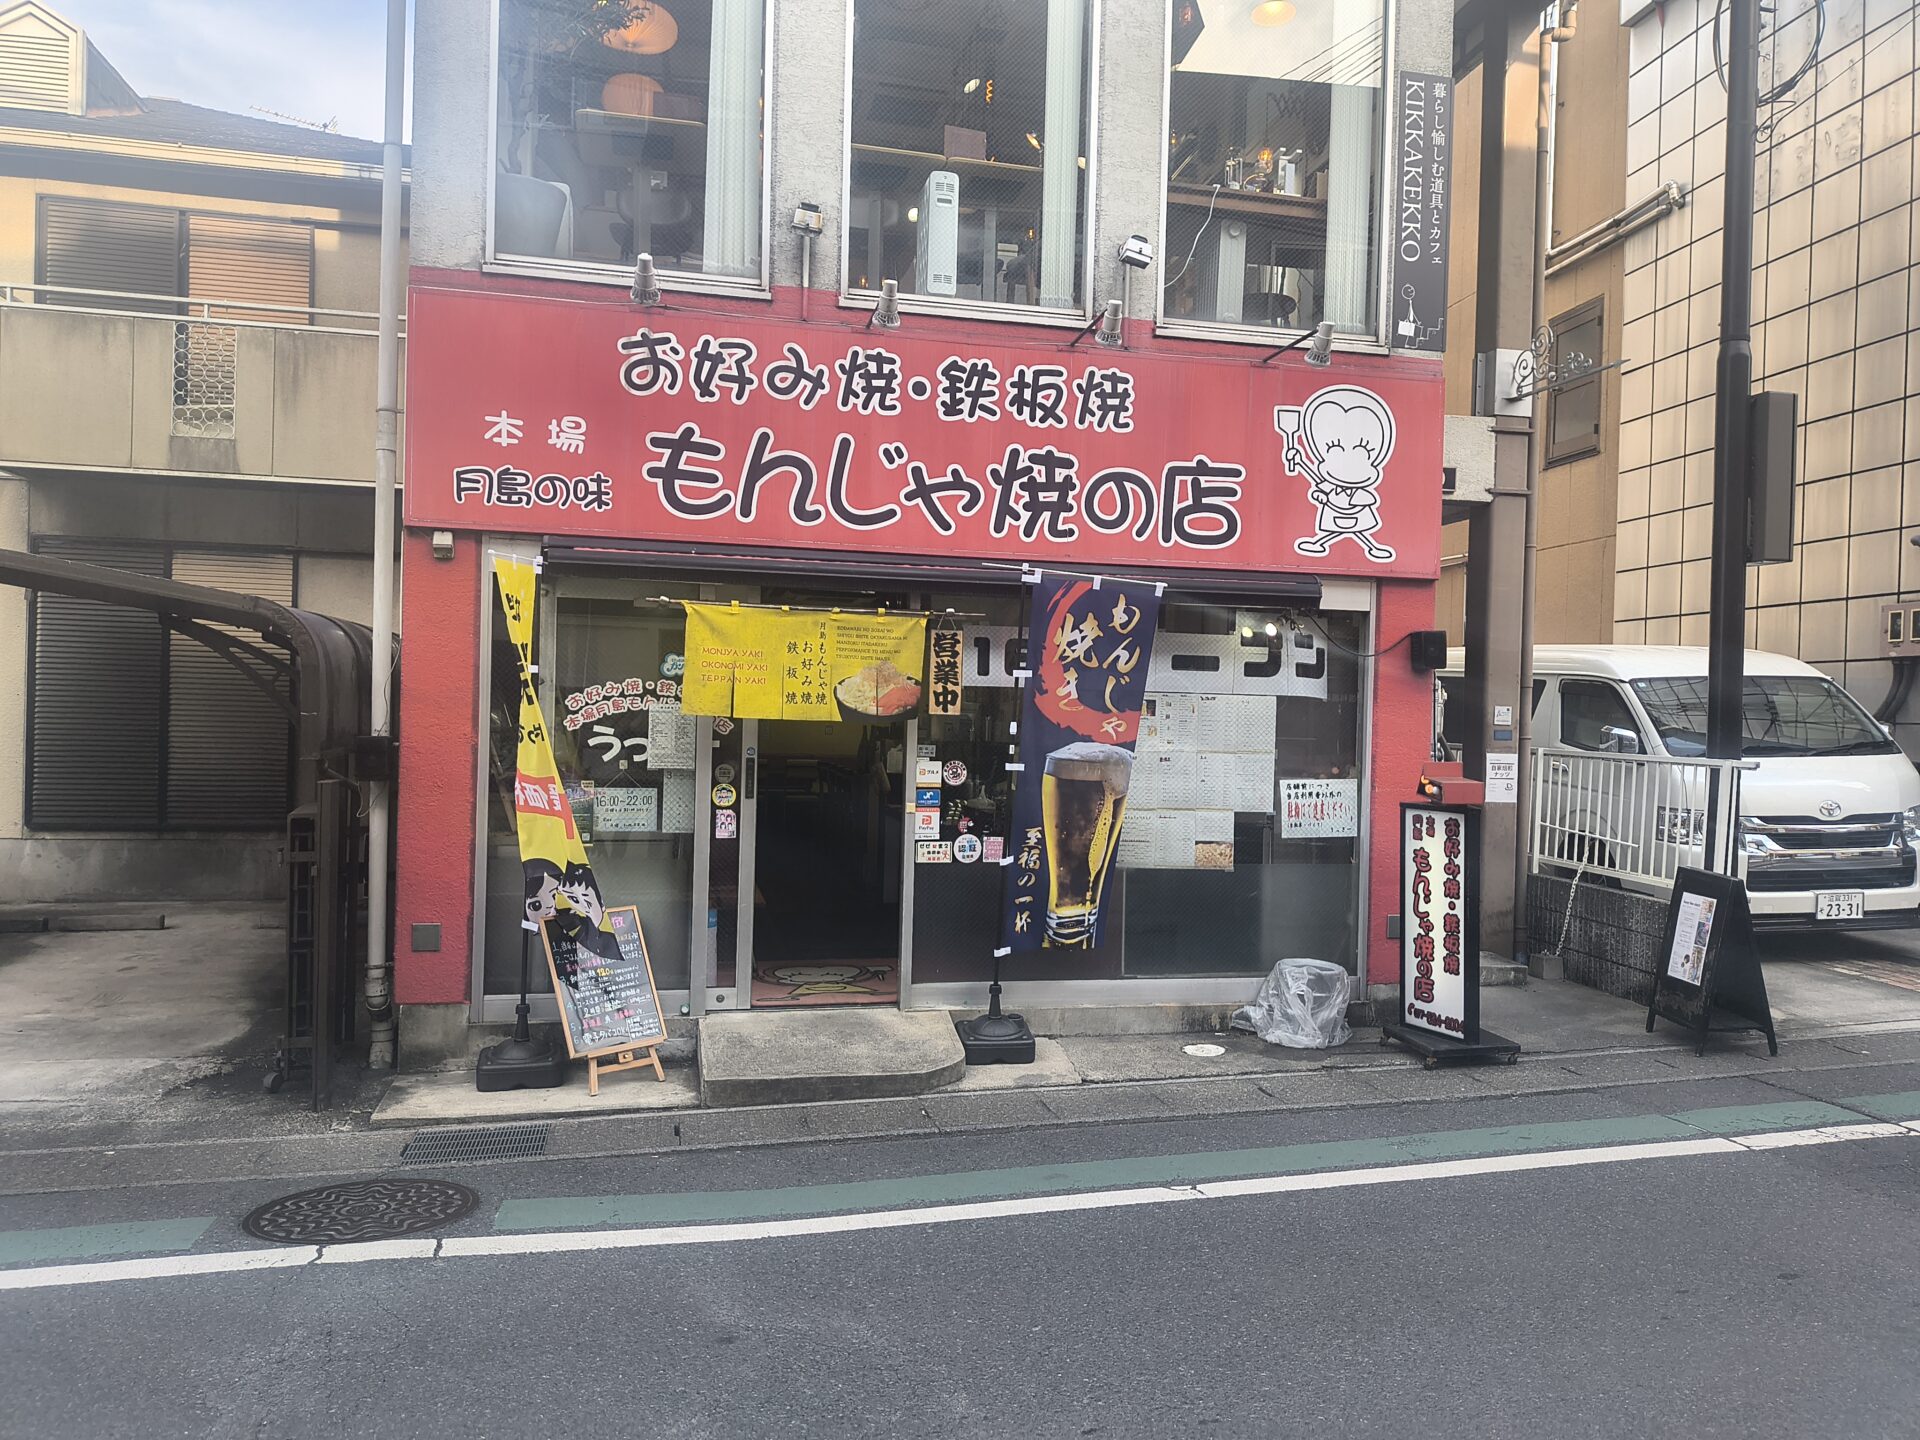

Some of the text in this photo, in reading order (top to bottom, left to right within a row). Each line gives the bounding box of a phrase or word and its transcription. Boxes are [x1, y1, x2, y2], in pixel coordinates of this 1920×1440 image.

[1400, 78, 1425, 263] KIKKAKEKKO
[1428, 82, 1446, 264] 暮らし愉しむ道具とカフェ
[617, 327, 1135, 433] お好み焼・鉄板焼
[484, 410, 588, 455] 本場
[453, 465, 613, 511] 月島の味
[642, 422, 1246, 549] もんじゃ焼の店
[701, 660, 768, 672] OKONOMI YAKI
[701, 673, 766, 685] TEPPAN YAKI
[702, 647, 763, 658] MONJYA YAKI
[785, 640, 799, 705] 鉄板焼
[800, 640, 813, 705] お好み焼
[932, 632, 961, 713] 営業中
[565, 678, 684, 711] お好み焼・鉄
[1013, 826, 1043, 934] 至福の一杯
[1826, 902, 1859, 917] 23-31
[1841, 894, 1853, 902] 331
[1412, 846, 1434, 1003] もんじゃ焼の店
